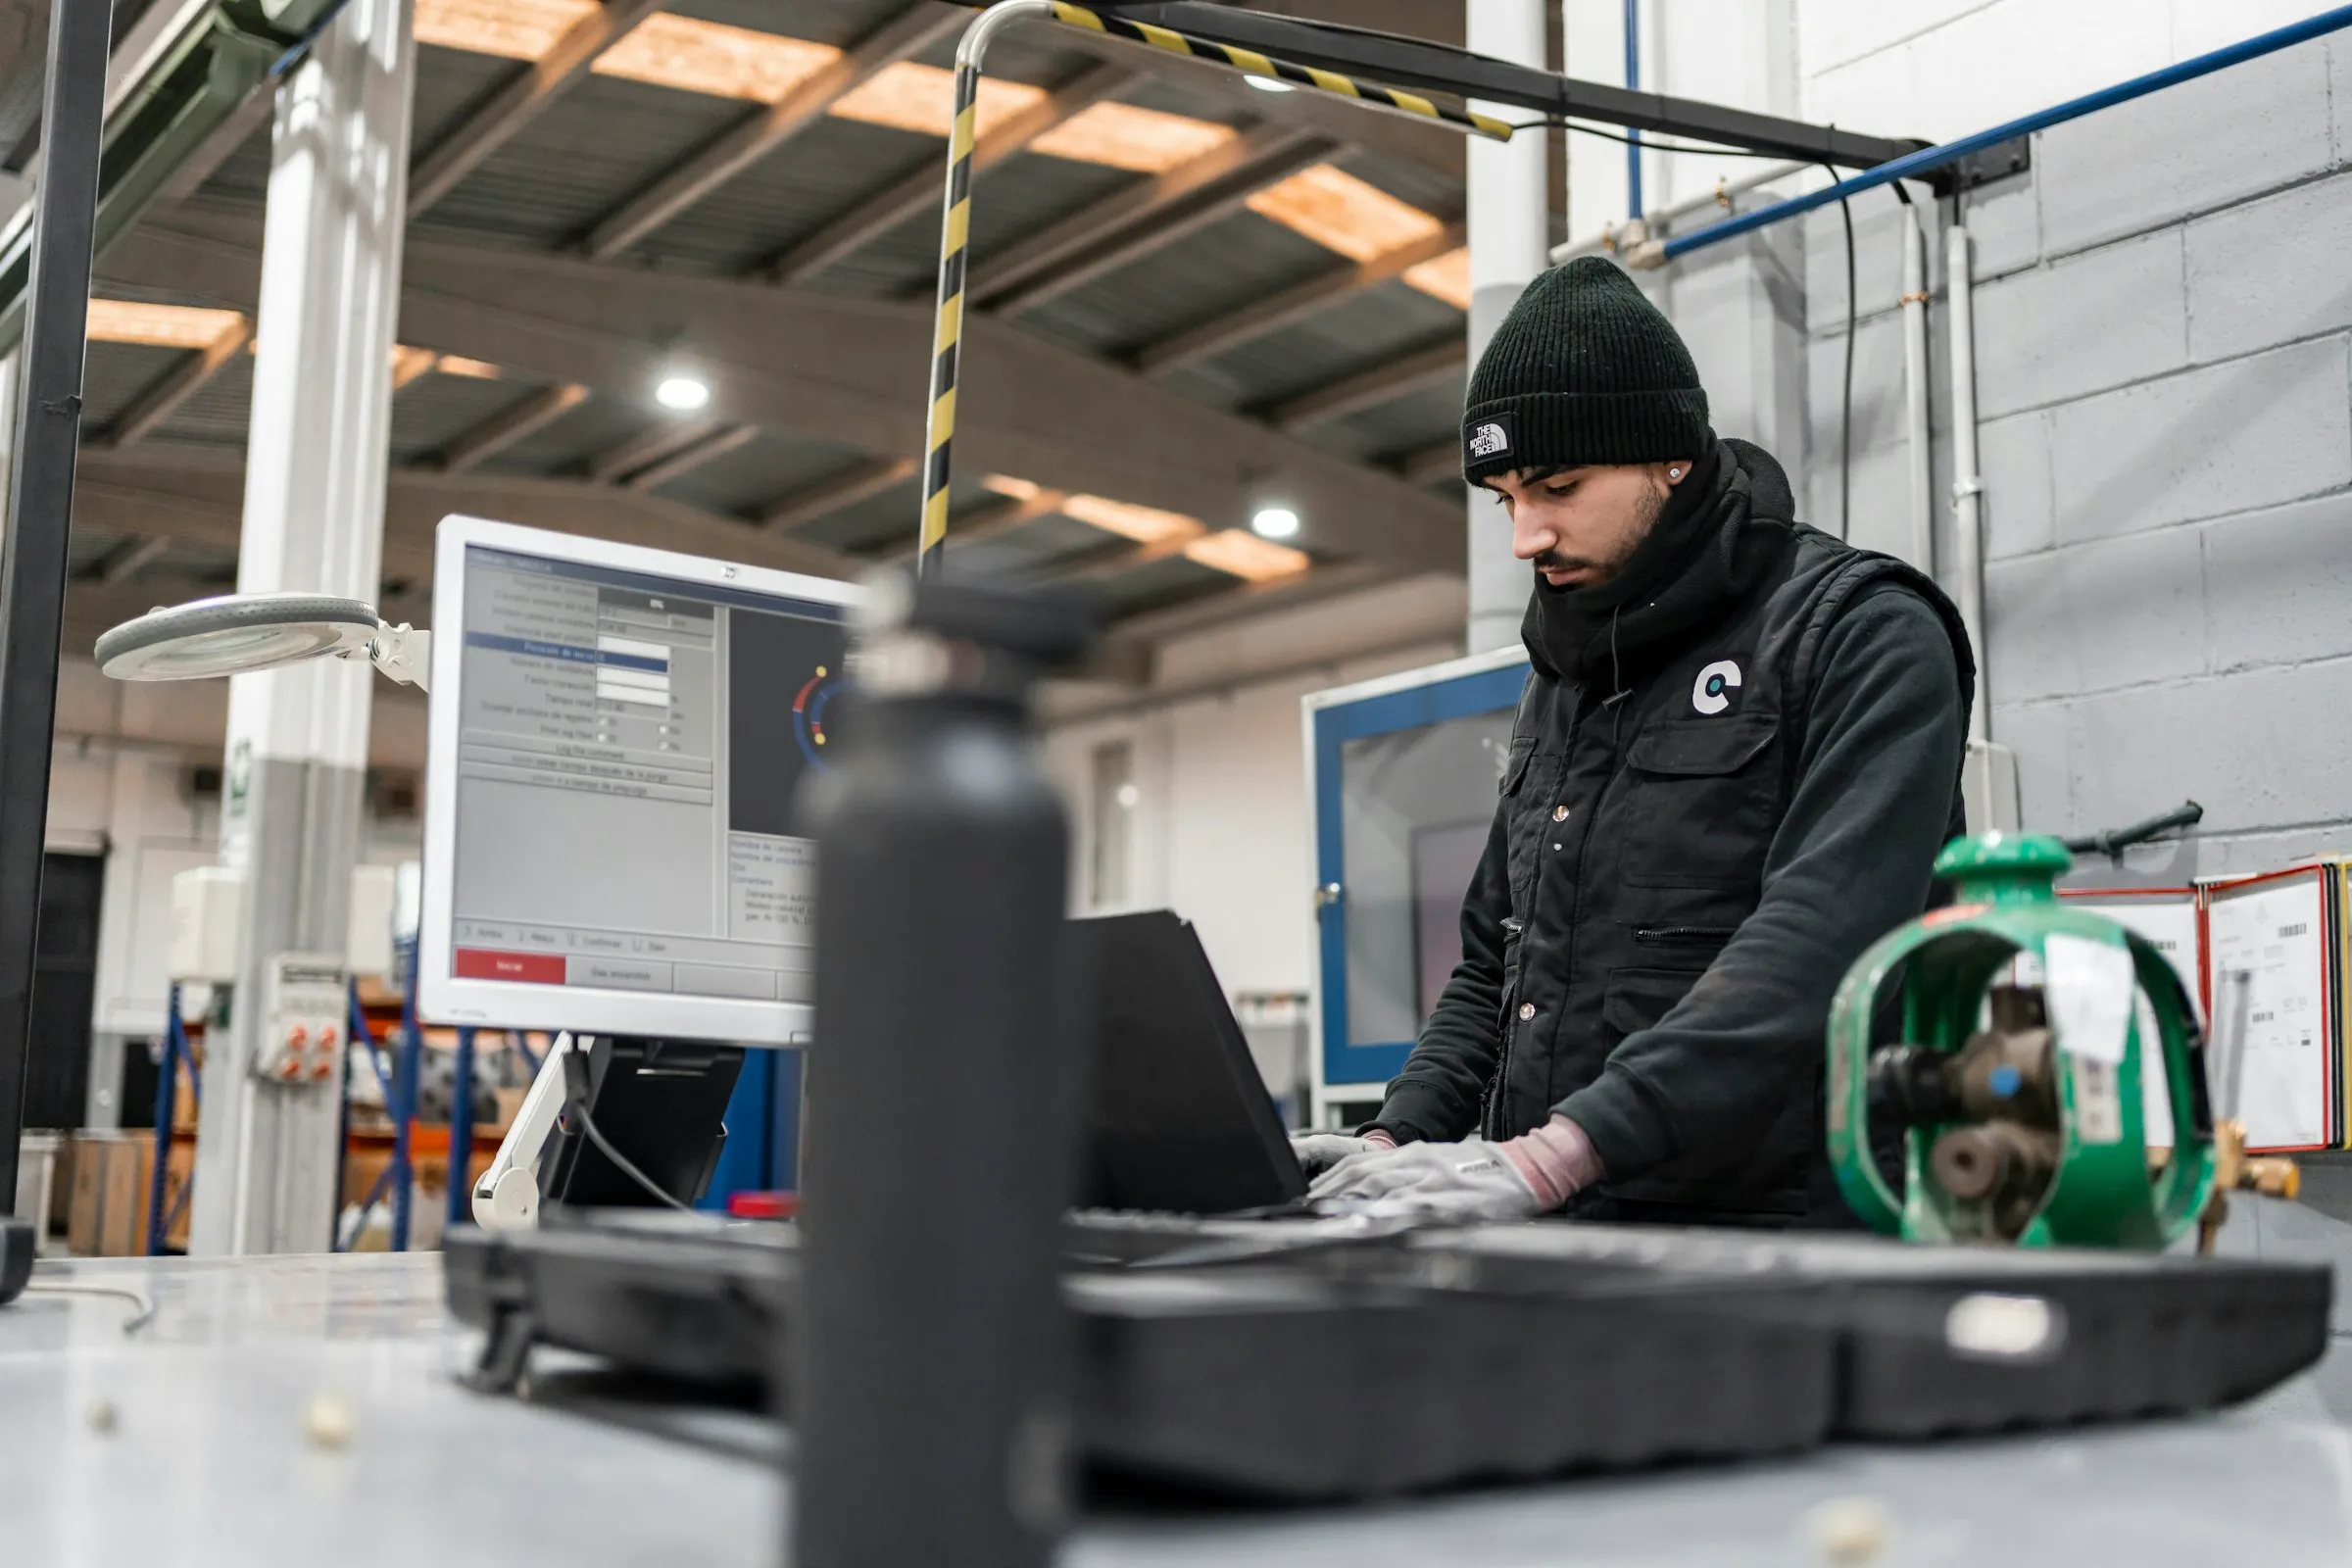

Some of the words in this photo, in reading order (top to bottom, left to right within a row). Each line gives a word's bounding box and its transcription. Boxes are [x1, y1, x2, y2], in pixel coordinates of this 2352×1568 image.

[1477, 424, 1491, 437] THE
[1470, 434, 1492, 450] NORTH
[1475, 444, 1493, 458] FACE
